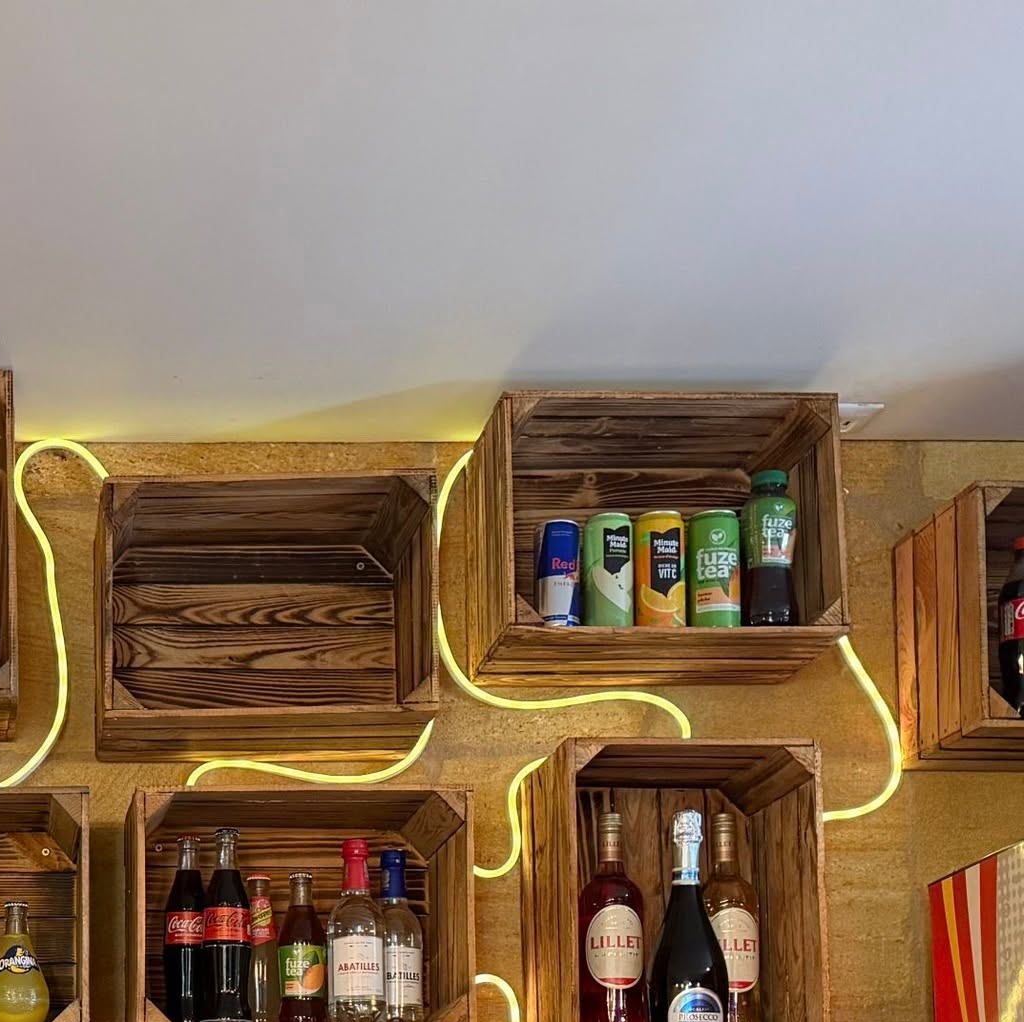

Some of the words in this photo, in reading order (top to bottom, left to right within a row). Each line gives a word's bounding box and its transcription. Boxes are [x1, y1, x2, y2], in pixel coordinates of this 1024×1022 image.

[762, 514, 793, 529] fuze
[606, 535, 628, 543] Minute
[653, 539, 679, 547] Minute
[696, 549, 737, 566] fuze
[551, 557, 575, 570] Red
[696, 564, 730, 580] tea
[590, 936, 641, 949] LILLET
[719, 939, 757, 952] LLET
[286, 958, 310, 968] fuze
[337, 962, 380, 972] ABATILLES
[286, 967, 303, 976] tea
[386, 971, 420, 981] BATILLES
